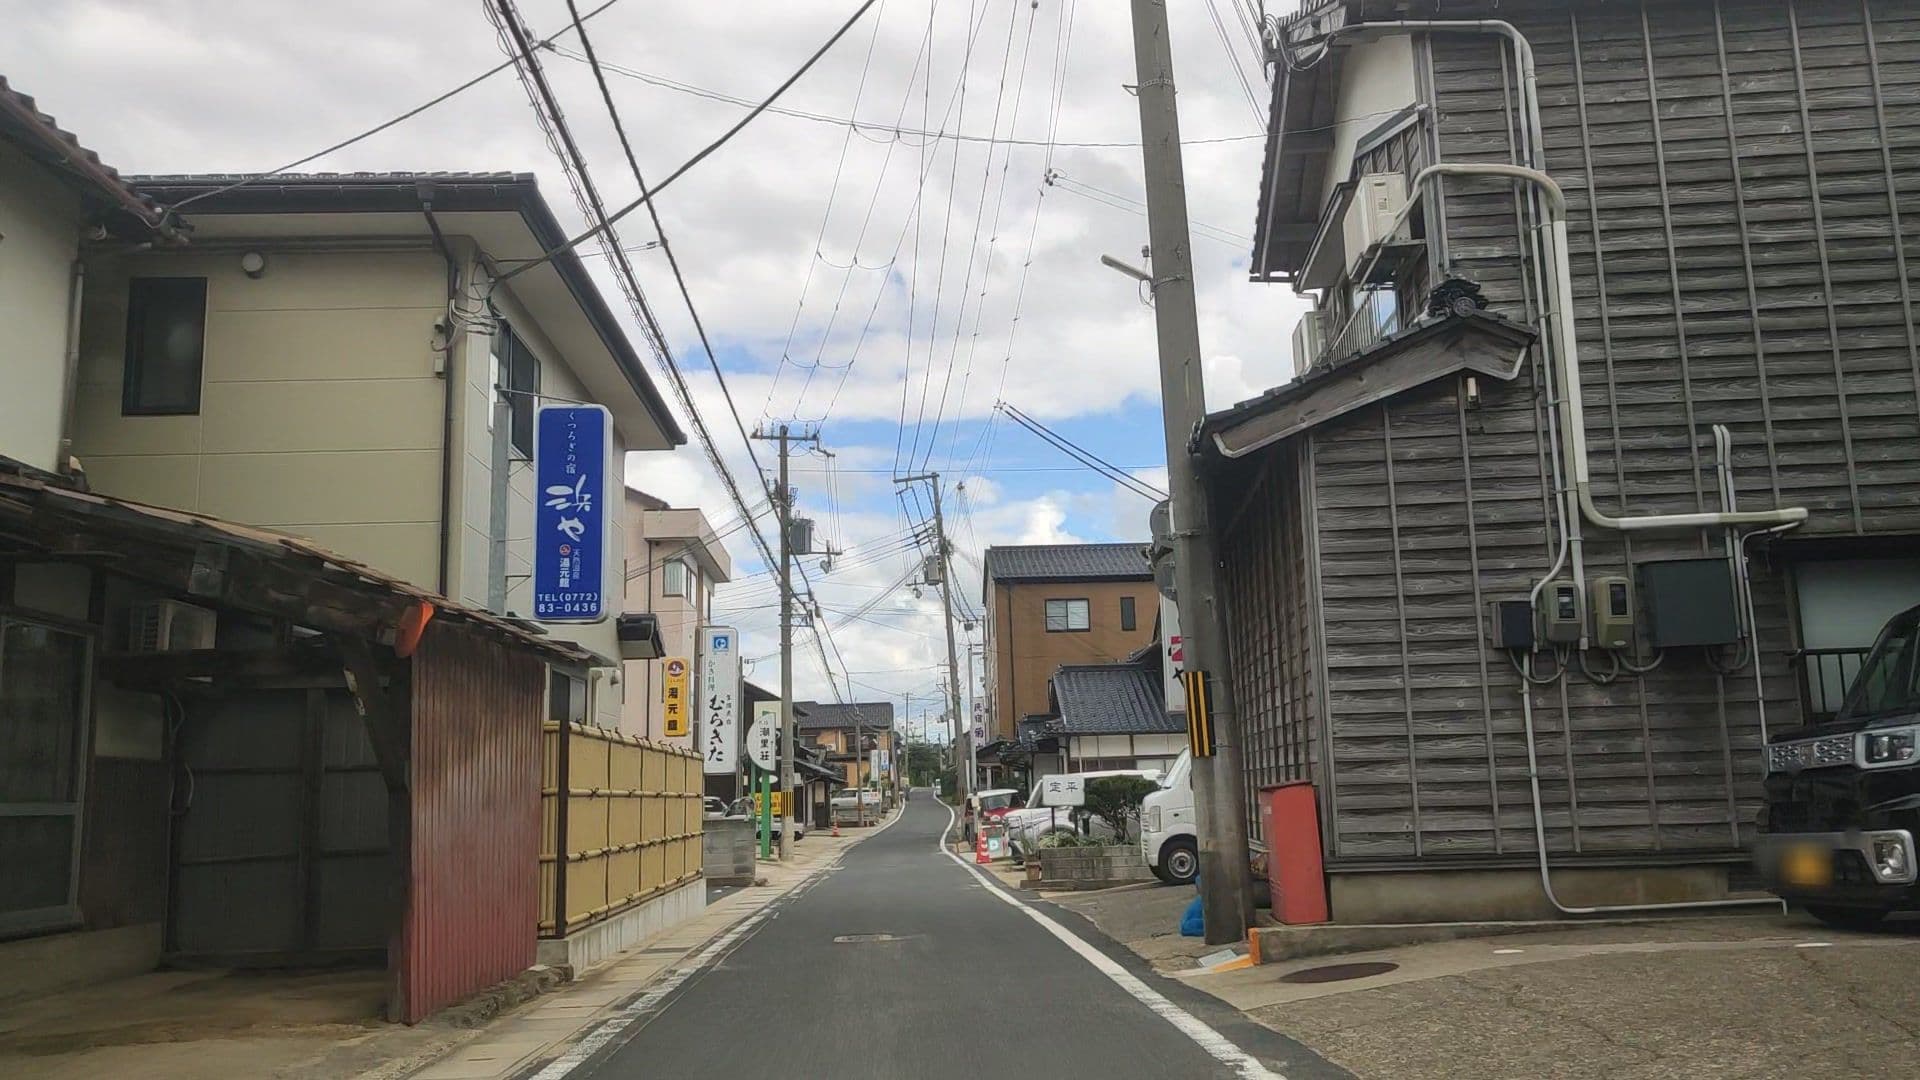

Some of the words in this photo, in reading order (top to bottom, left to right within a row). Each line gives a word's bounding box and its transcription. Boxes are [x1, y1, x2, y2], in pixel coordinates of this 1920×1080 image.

[565, 411, 577, 474] くつろぎの宿
[538, 592, 598, 602] TEL(0772)
[538, 602, 597, 613] 83-0436
